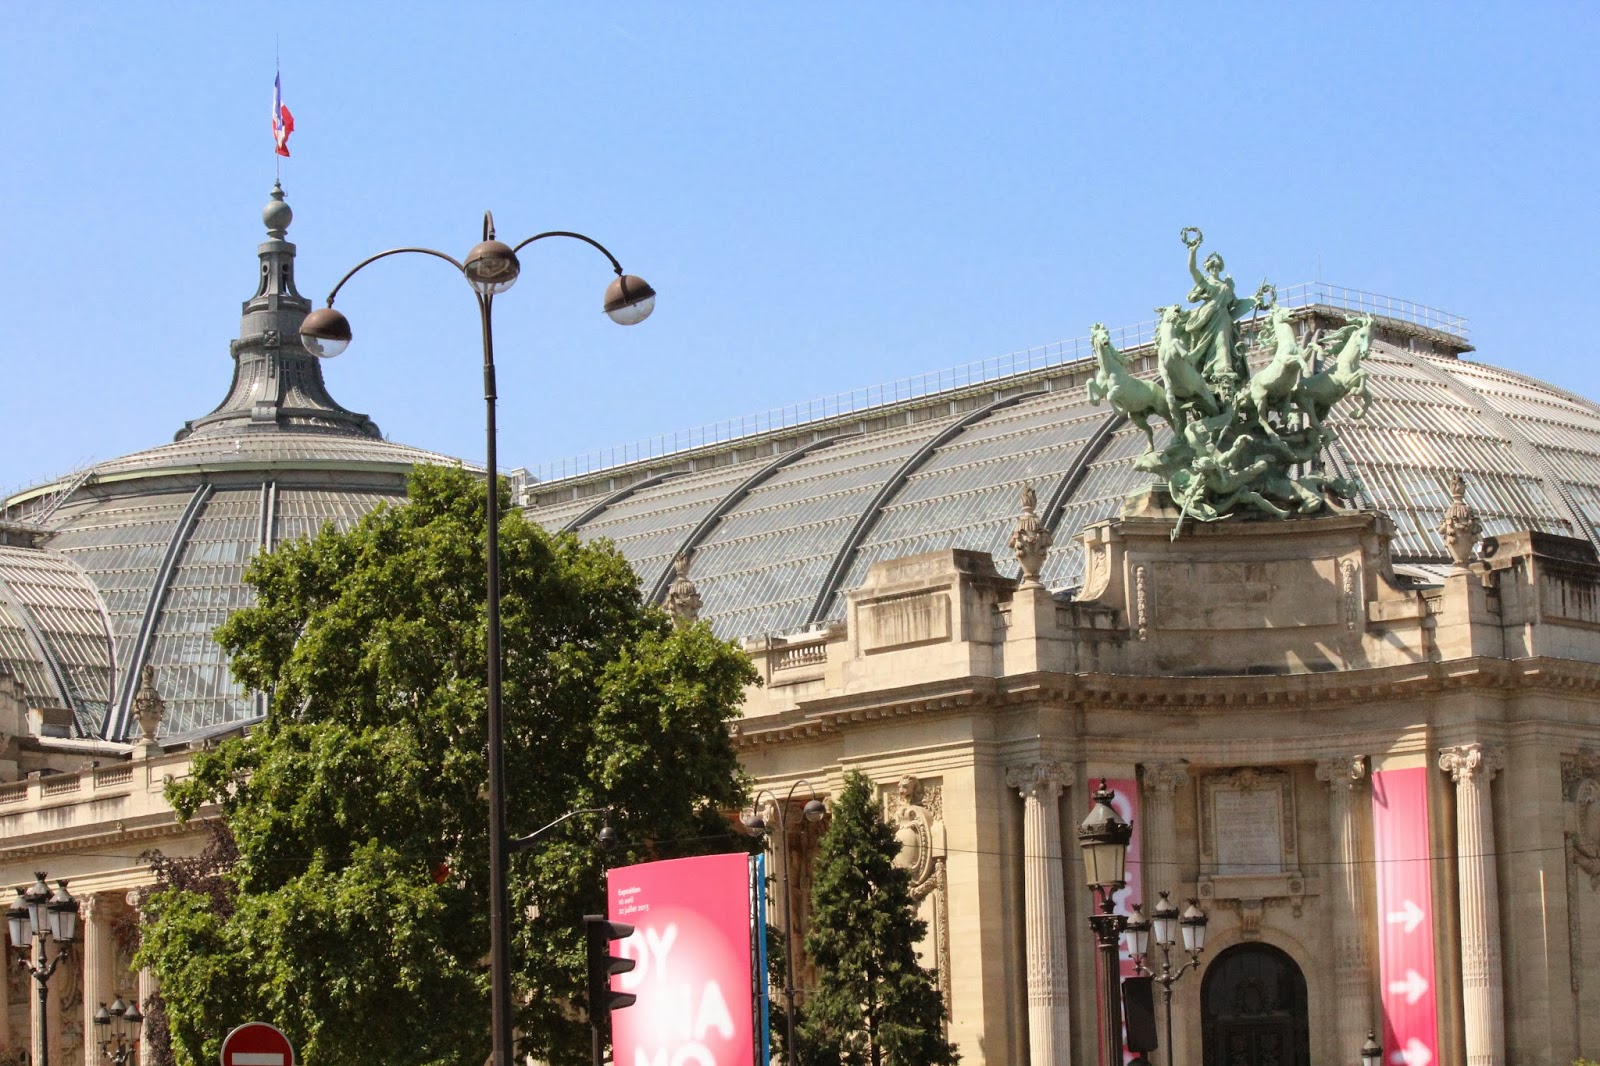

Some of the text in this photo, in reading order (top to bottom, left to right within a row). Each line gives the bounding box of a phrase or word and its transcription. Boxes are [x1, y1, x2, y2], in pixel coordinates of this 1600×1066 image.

[618, 887, 641, 897] Exposition
[624, 895, 634, 906] avril
[624, 905, 637, 916] juillet
[620, 925, 677, 990] DY
